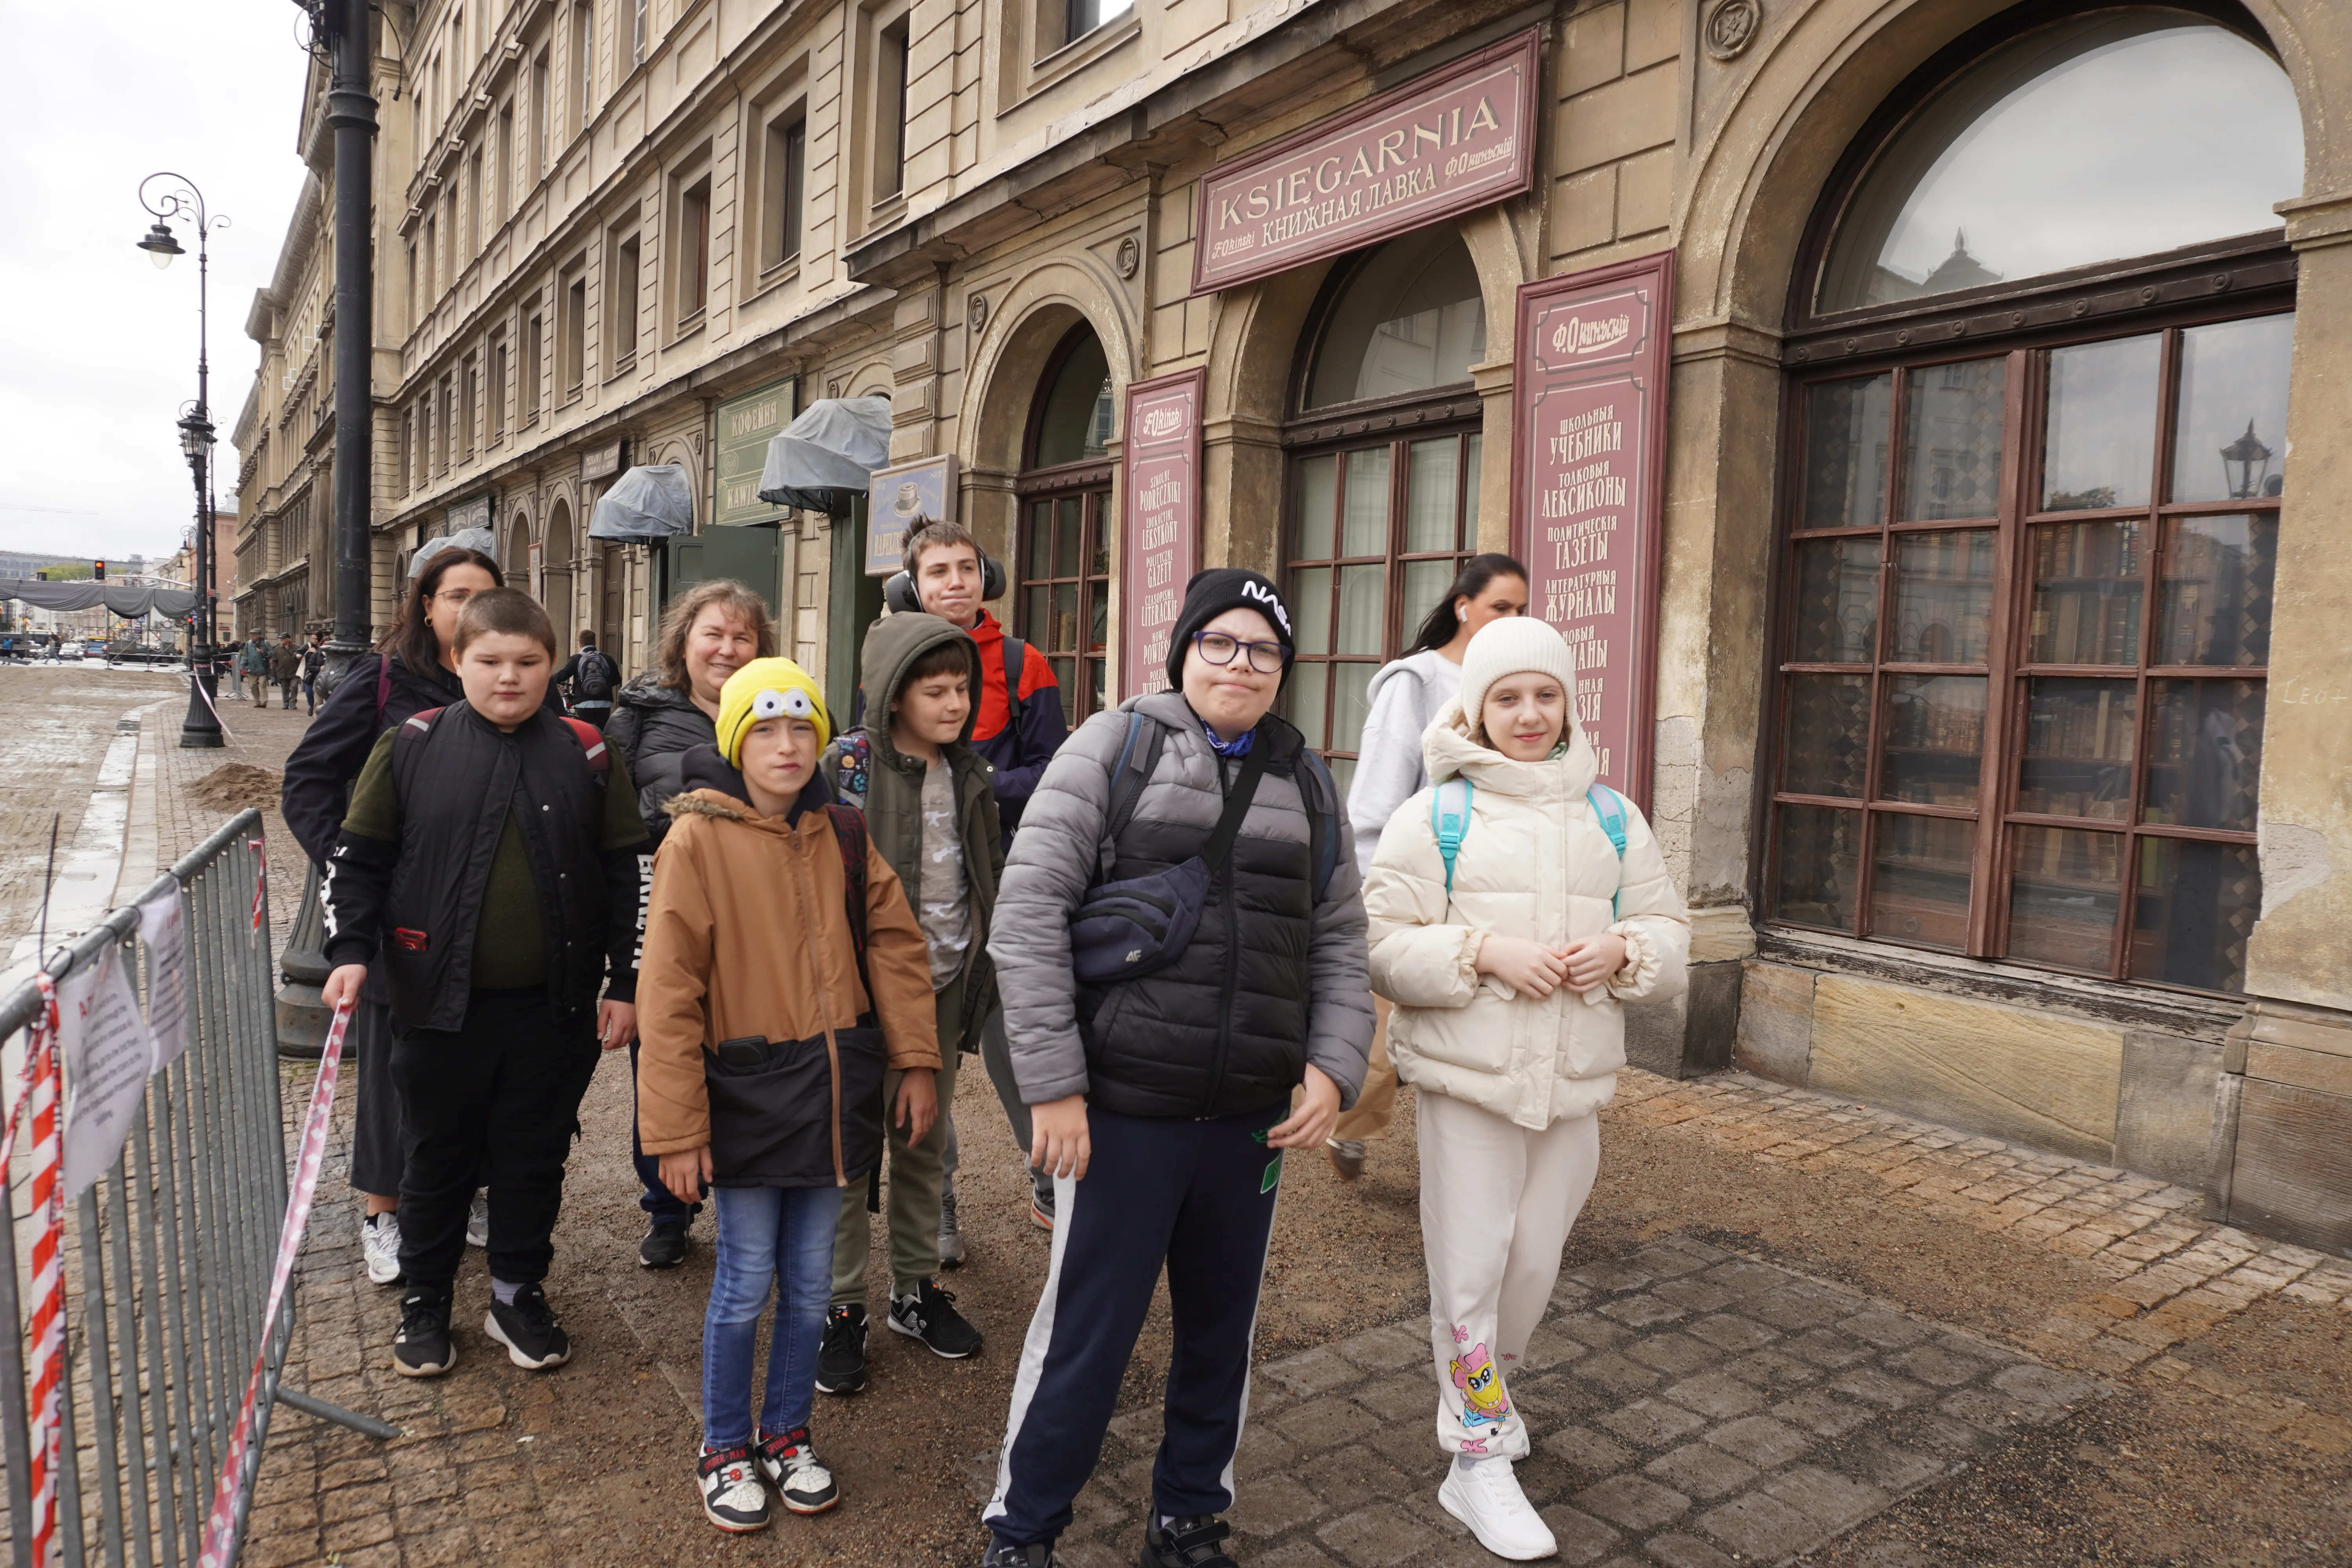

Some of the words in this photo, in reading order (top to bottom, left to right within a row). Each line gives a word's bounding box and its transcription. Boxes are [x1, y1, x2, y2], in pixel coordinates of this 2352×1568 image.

[1220, 96, 1499, 230] KSIĘGARNIA
[1261, 192, 1362, 247] КНИЖНАЯ
[1366, 163, 1437, 213] ЛАВКА
[732, 401, 777, 437] КОФЕЙНЯ
[1560, 404, 1614, 435] ШКОЛЬНЫЯ
[1550, 421, 1622, 466] УЧЕБНИКИ
[1151, 470, 1170, 489] SZKOLNE
[1559, 461, 1610, 488] ТОЛКОВЫЯ
[1140, 482, 1180, 512] PODRĘCZNIKI
[1542, 477, 1626, 518] ЛЕКСИКОНЫ
[1146, 509, 1173, 528] EDUKACYJNE
[1548, 515, 1617, 542] ПОЛИТИЧЕСКІЯ
[1142, 521, 1178, 550] LEKSYKONY
[1146, 549, 1173, 568] POLITYCZNE
[1556, 532, 1608, 570] ГАЗЕТЫ
[1148, 561, 1172, 588] GAZETY
[1545, 570, 1617, 594] ЛИТЕРАТУРНЫЯ
[1145, 588, 1174, 606] CZASOPISMA
[1241, 581, 1291, 637] NASA
[1545, 586, 1616, 622] ЖУРНАЛЫ
[1142, 600, 1178, 627] LITERACKIE
[1152, 629, 1165, 643] NOWE
[1563, 625, 1595, 644] НОВЫЯ
[1143, 636, 1171, 665] POWIEŚ
[1568, 640, 1608, 671] МАНЫ
[1150, 668, 1166, 682] POEZJA
[406, 1296, 421, 1305] adidas
